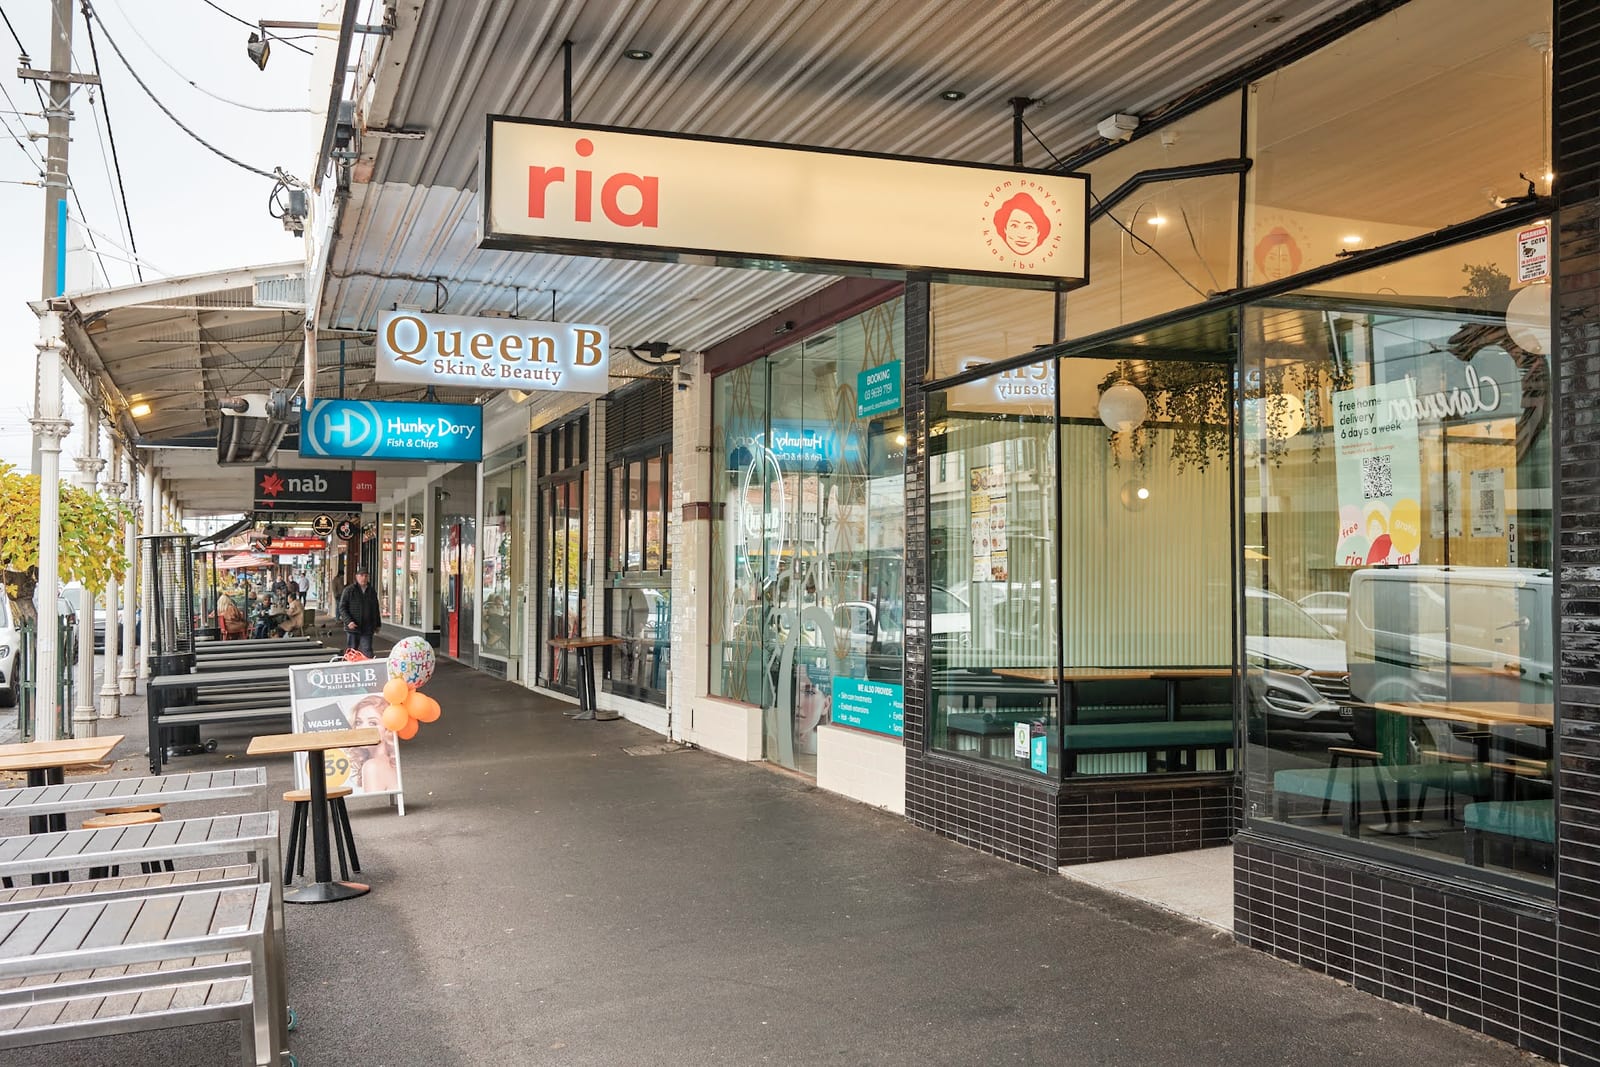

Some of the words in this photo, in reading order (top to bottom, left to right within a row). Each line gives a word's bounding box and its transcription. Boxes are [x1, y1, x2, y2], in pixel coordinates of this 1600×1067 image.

[528, 138, 660, 229] ria
[983, 180, 1012, 207] ayam
[1020, 179, 1061, 214] penyet
[983, 229, 1005, 261] khas
[1013, 260, 1034, 270] ibu
[1042, 235, 1062, 263] ruth
[1531, 237, 1546, 246] CCTV
[386, 316, 558, 366] Queen
[573, 328, 602, 367] B
[434, 360, 477, 376] Skin
[481, 363, 496, 377] &
[500, 364, 562, 385] Beauty
[866, 369, 890, 386] BOOKING
[1339, 401, 1356, 412] free
[387, 417, 435, 438] Hunky
[437, 418, 476, 439] Dory
[1340, 413, 1375, 426] delivery
[1340, 429, 1347, 439] 6
[1348, 427, 1369, 438] days
[1371, 426, 1377, 435] a
[1379, 420, 1401, 433] week
[386, 438, 405, 447] Fish
[414, 439, 439, 450] Chips
[287, 474, 328, 493] nab
[1342, 522, 1358, 538] free
[1345, 551, 1363, 568] ria
[310, 670, 360, 689] QUEEN
[857, 684, 864, 692] WE
[864, 685, 874, 694] ALSO
[307, 720, 334, 728] WASH
